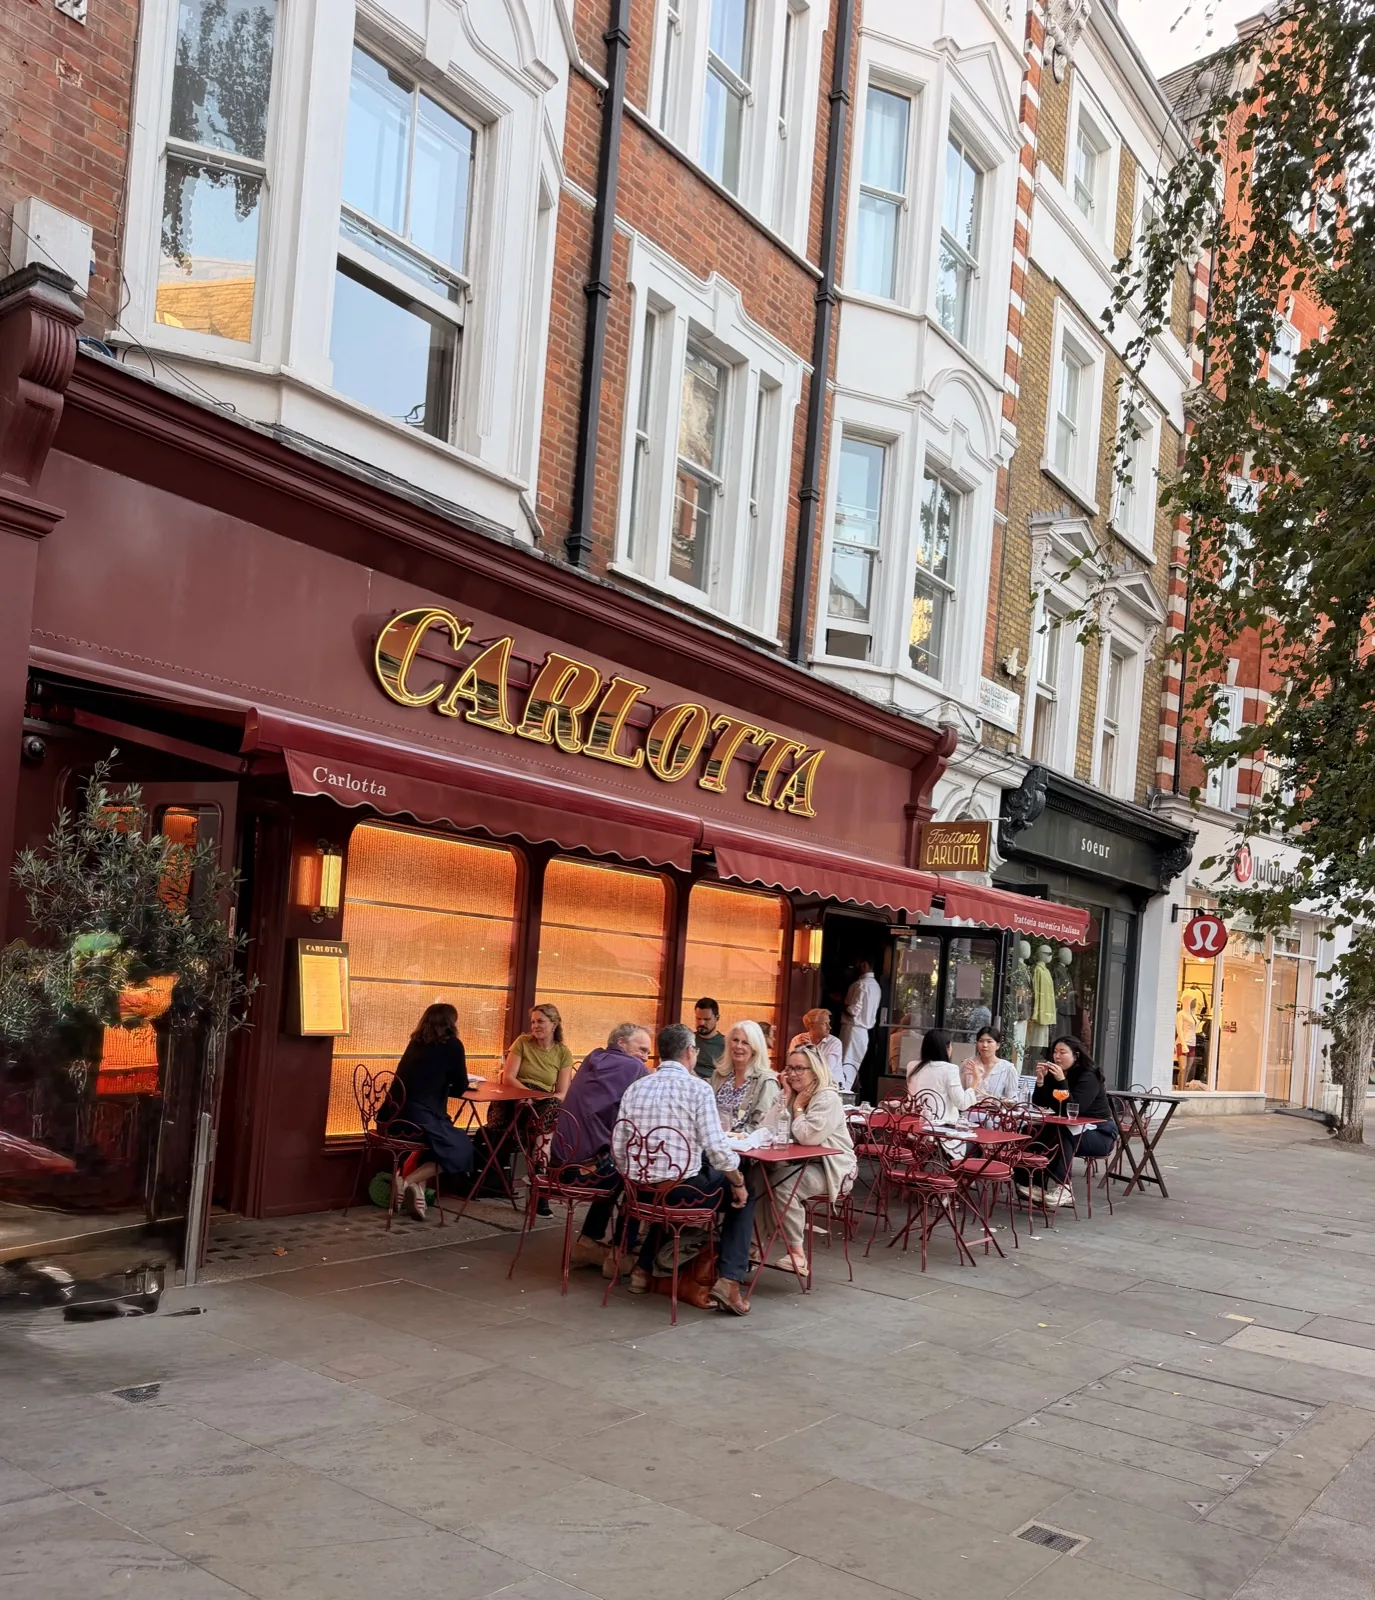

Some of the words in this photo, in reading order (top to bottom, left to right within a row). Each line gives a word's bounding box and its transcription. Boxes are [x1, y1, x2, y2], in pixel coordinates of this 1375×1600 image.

[374, 605, 827, 818] CARLOTTA
[312, 766, 387, 797] Carlotta
[927, 828, 982, 845] Trattoria
[926, 844, 979, 865] CARLOTTA
[1081, 838, 1110, 859] soeur
[1013, 913, 1037, 927] Trattoria
[1061, 923, 1081, 936] Italiana
[306, 944, 343, 954] CARLOTTA
